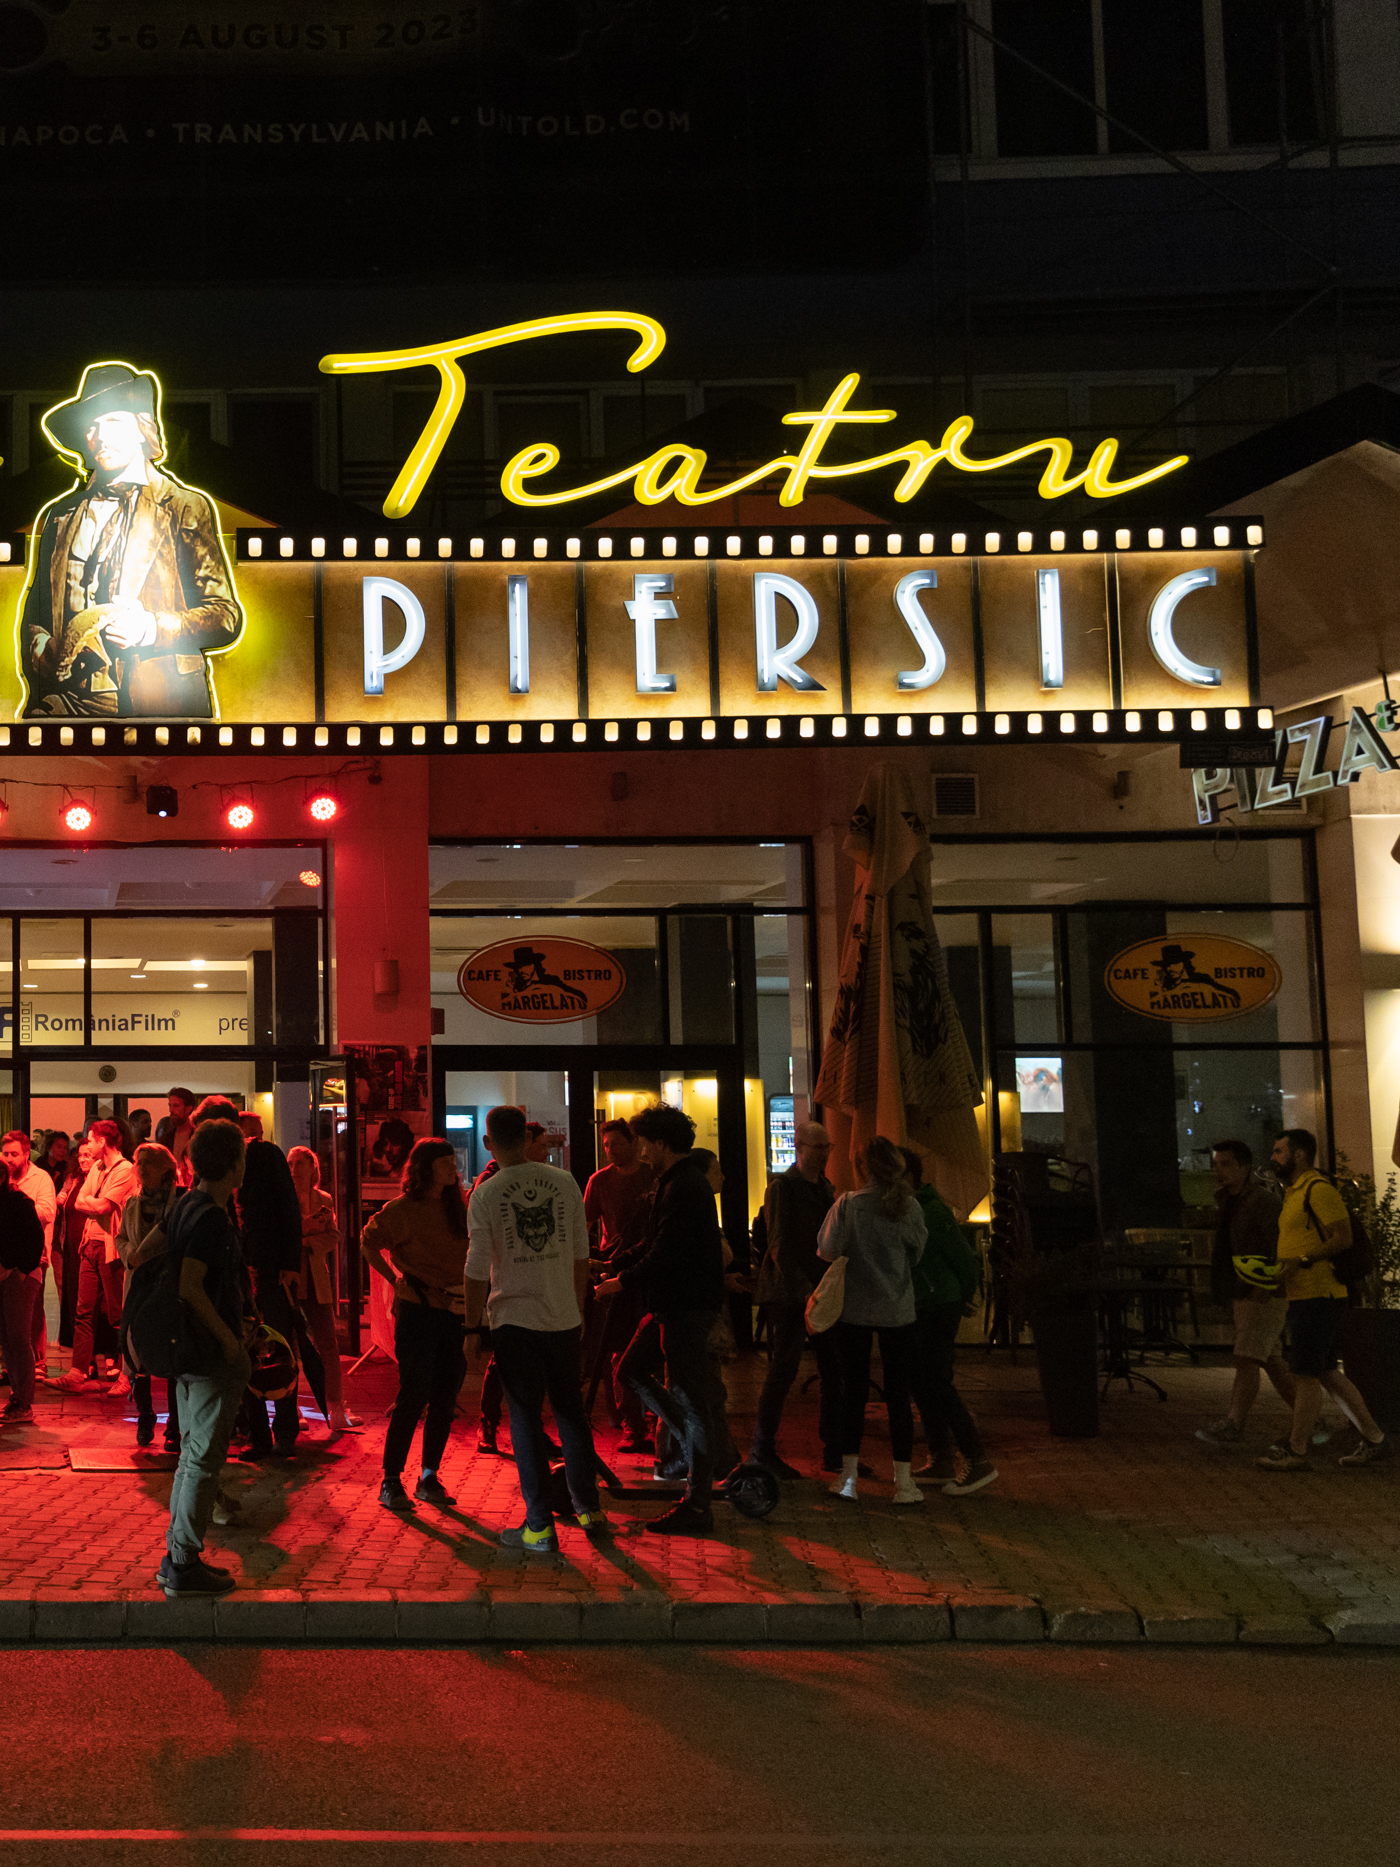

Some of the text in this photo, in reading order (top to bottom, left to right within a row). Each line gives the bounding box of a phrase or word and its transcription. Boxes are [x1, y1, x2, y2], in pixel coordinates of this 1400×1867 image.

[91, 8, 480, 52] 3-6 AUGUST 2023
[172, 115, 435, 145] TRANSYLVANIA
[476, 106, 692, 137] UNTOLD.COM
[319, 311, 1189, 519] Teatru
[363, 566, 1223, 696] PIERSIC
[1191, 707, 1394, 825] PIZZA
[467, 969, 612, 982] CAFE BISTRO
[1113, 966, 1266, 980] CAFE BISTRO
[218, 1017, 249, 1036] pre
